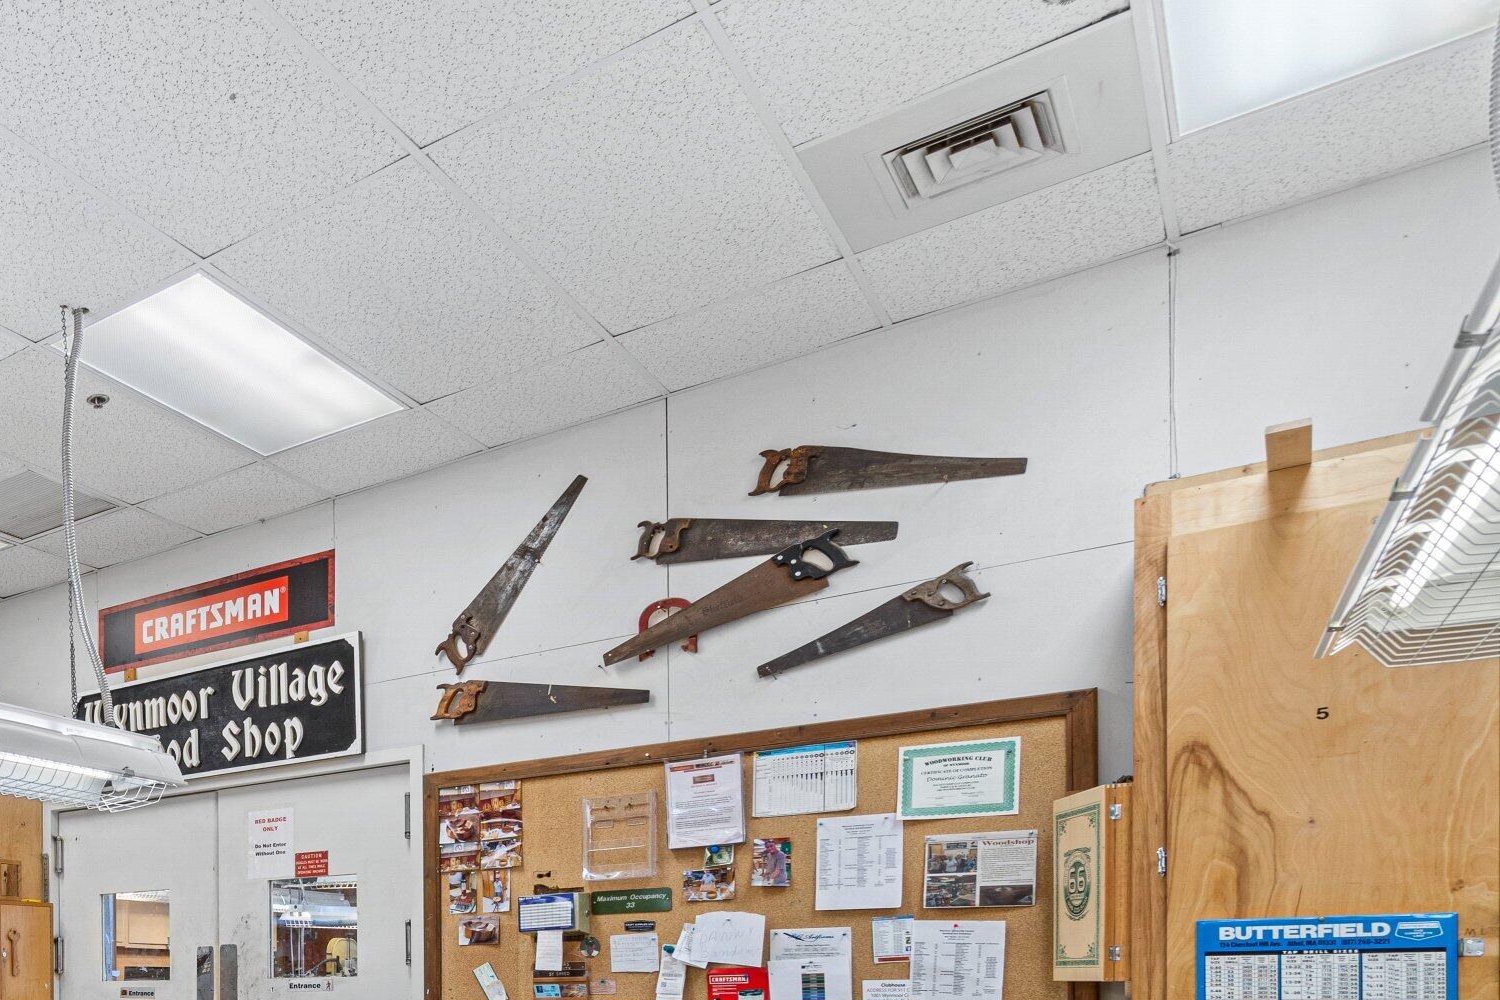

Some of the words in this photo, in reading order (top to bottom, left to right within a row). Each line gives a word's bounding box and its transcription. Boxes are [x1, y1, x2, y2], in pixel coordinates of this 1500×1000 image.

[142, 587, 281, 645] CRAFTSMAN
[231, 660, 345, 712] Village
[1316, 706, 1330, 721] 5
[221, 716, 304, 762] Shop
[924, 756, 974, 767] WOODWORKING
[267, 816, 287, 824] BADGE
[982, 839, 1035, 847] Woodshop
[596, 894, 628, 902] Maximum
[630, 893, 667, 901] Occupancy
[1218, 922, 1391, 941] BUTTERFIELD
[289, 982, 321, 990] Entrance
